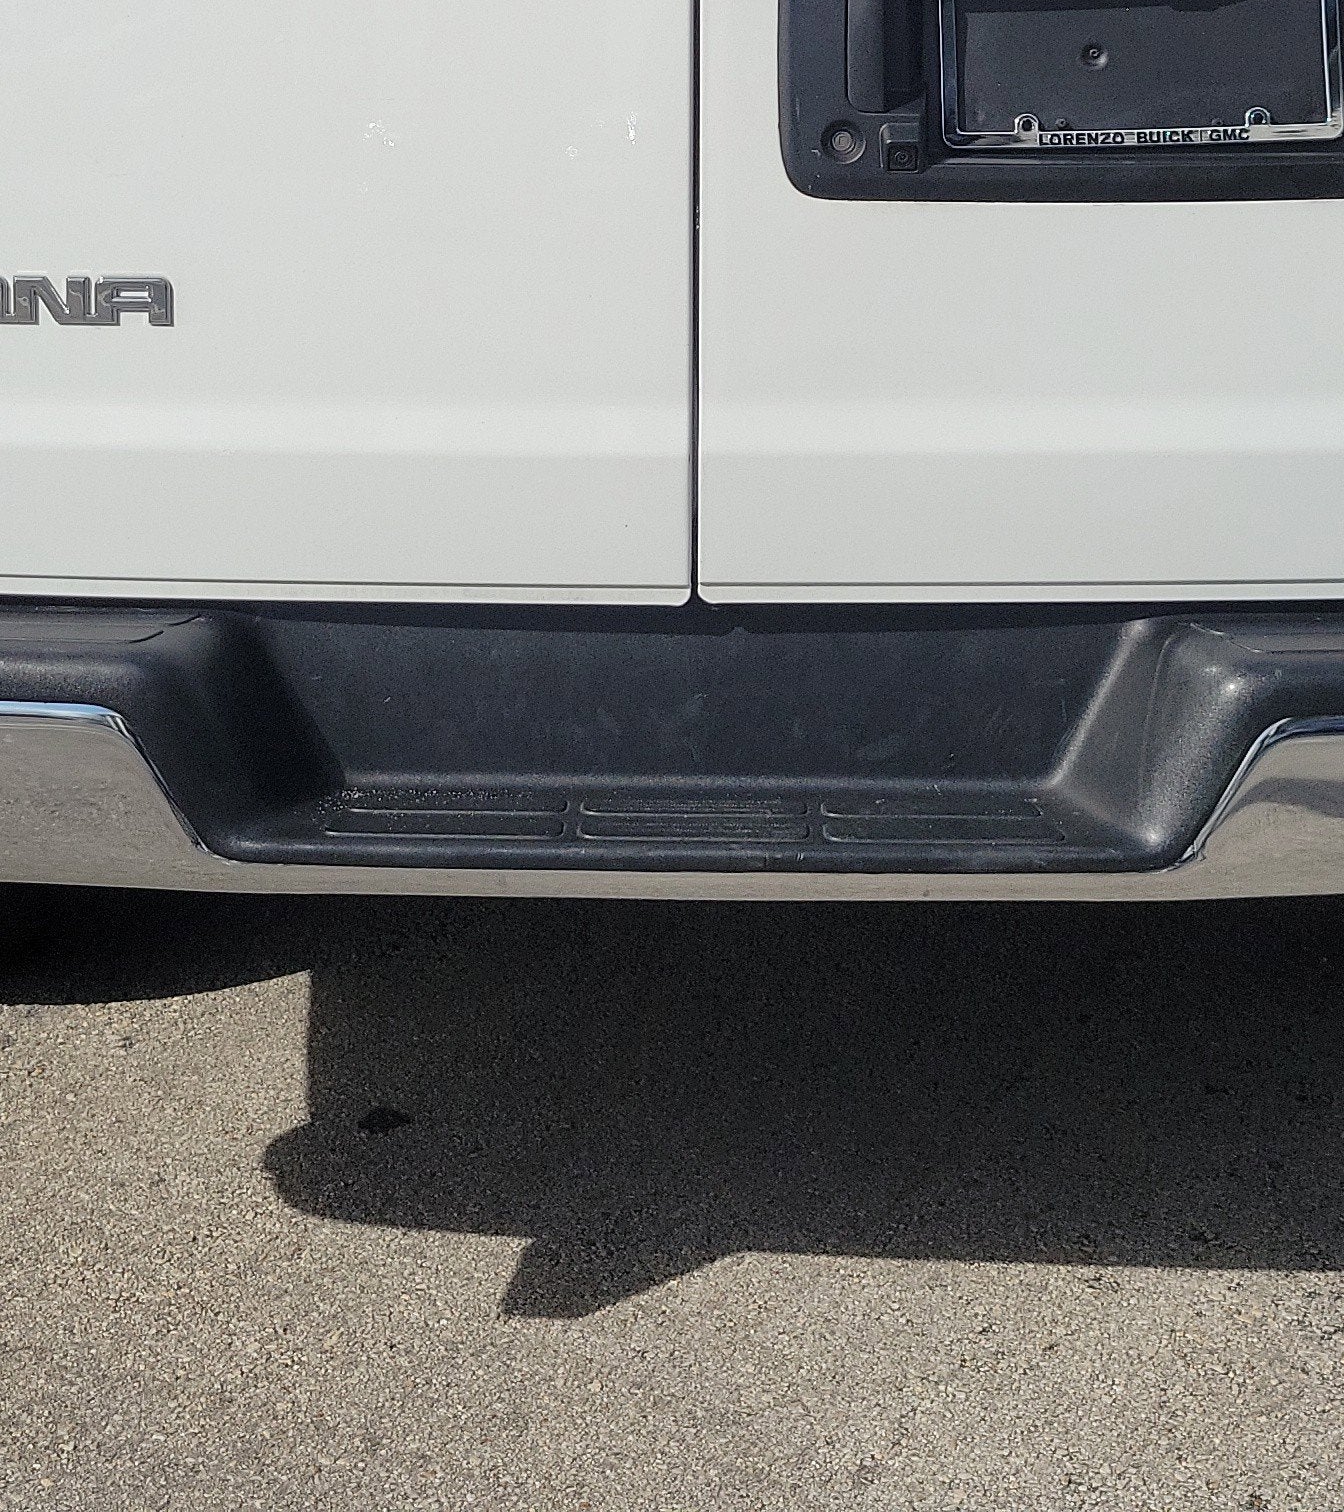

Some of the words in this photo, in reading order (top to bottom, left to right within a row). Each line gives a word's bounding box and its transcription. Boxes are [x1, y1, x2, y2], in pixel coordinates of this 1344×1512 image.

[1038, 132, 1125, 146] LORENZO
[1136, 130, 1195, 144] BUICK
[1208, 128, 1250, 141] GMC
